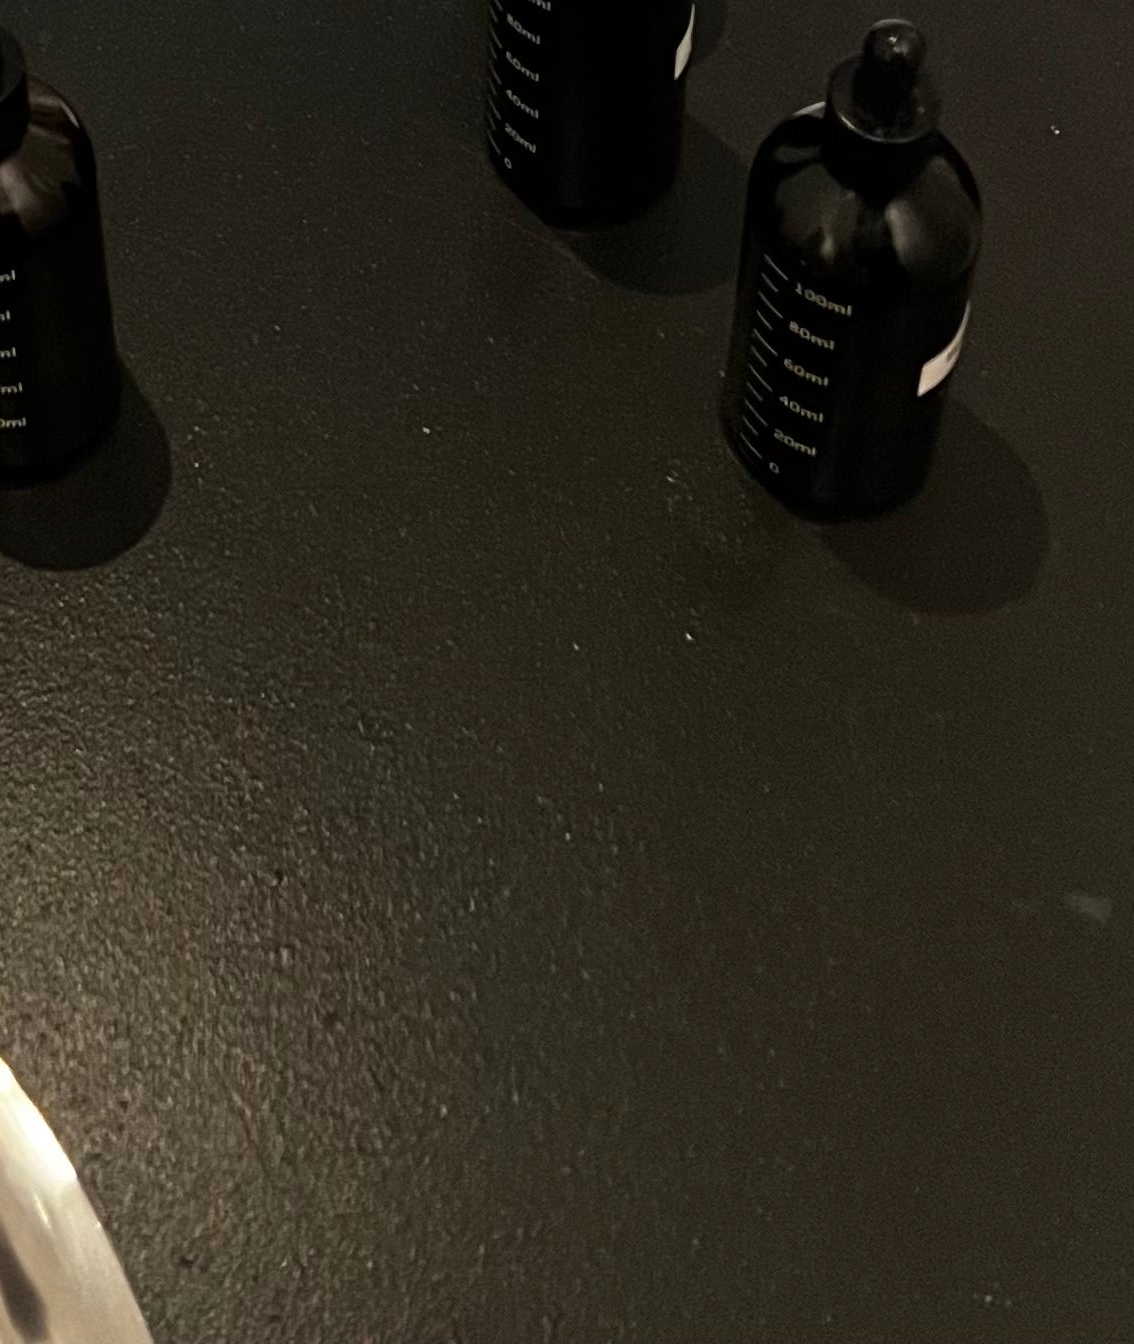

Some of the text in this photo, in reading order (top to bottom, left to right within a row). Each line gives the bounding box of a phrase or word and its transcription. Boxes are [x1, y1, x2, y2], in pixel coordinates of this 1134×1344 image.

[506, 12, 541, 45] 80ml
[505, 50, 540, 82] 60ml
[504, 122, 537, 154] 20ml
[503, 156, 513, 169] 0
[795, 281, 852, 317] 100ml
[788, 320, 835, 351] 80ml
[783, 358, 829, 388] 60ml
[778, 394, 824, 424] 40ml
[773, 427, 817, 458] 20ml
[769, 461, 780, 475] 0
